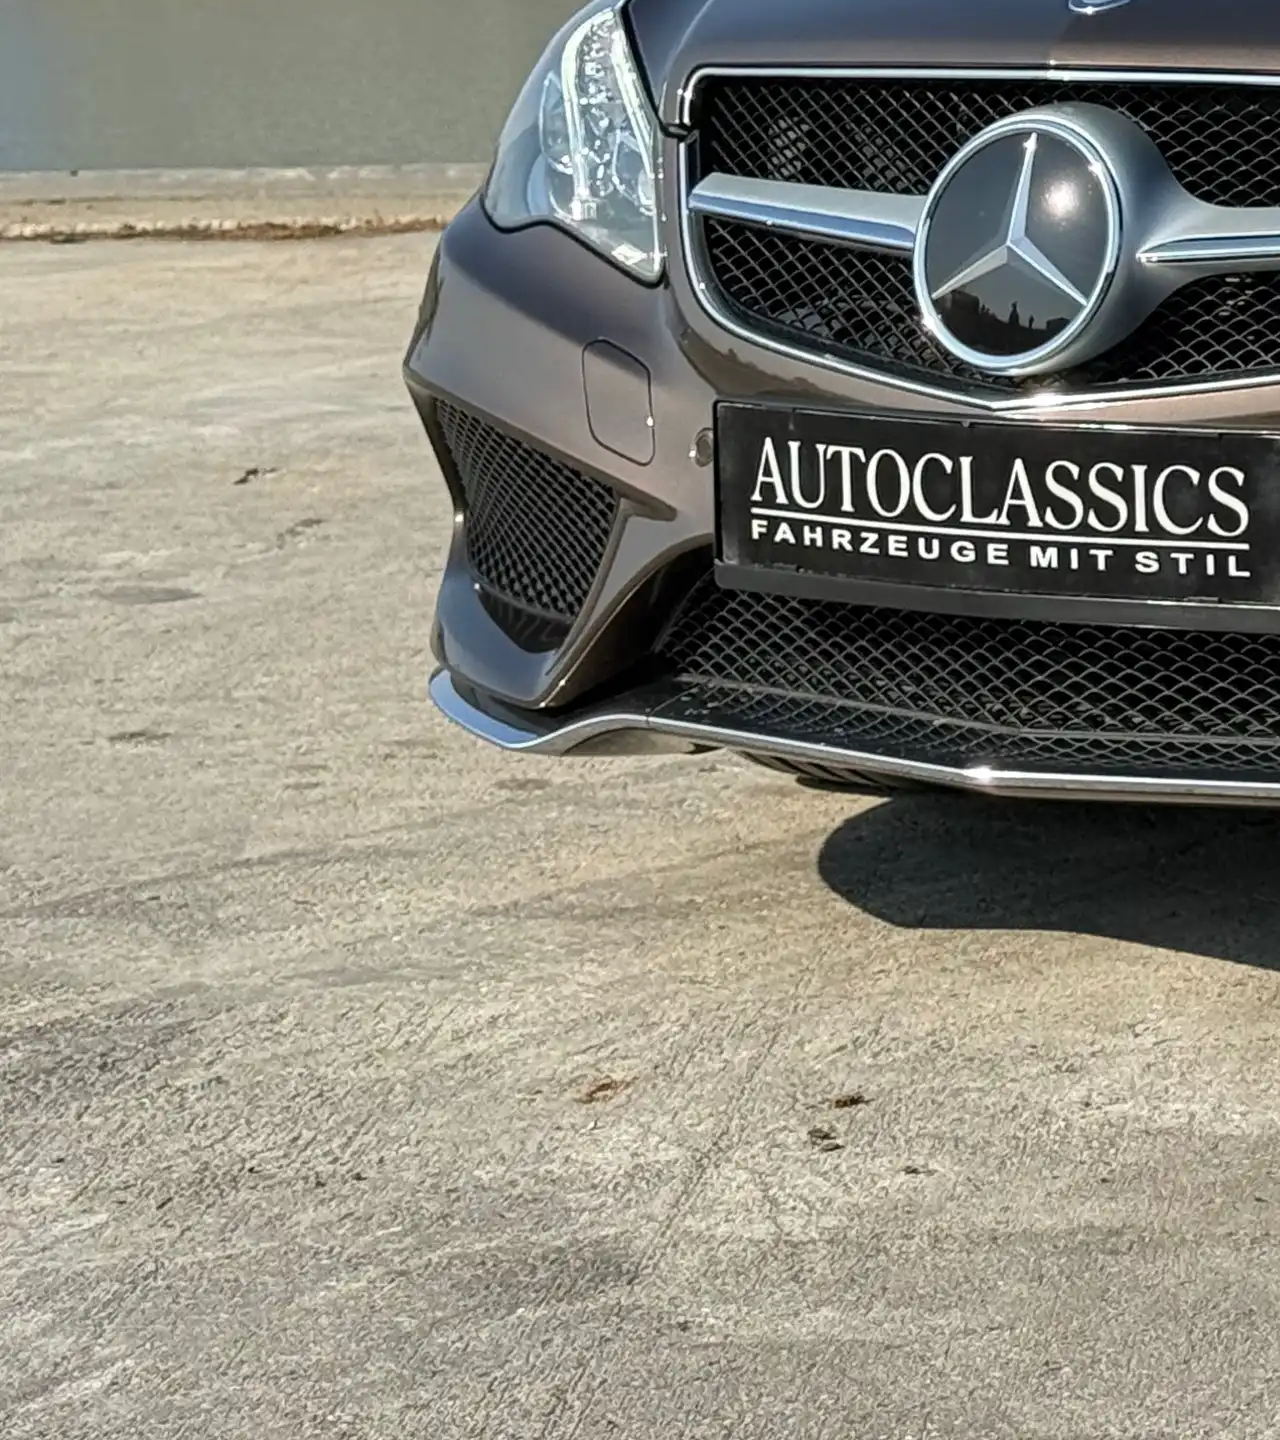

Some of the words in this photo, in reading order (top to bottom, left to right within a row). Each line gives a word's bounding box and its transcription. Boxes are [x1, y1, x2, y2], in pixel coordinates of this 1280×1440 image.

[750, 436, 1249, 538] AUTOCLASSICS
[751, 519, 1009, 565] FAHRZEUGE
[1029, 545, 1114, 571] MIT
[1134, 551, 1250, 578] STIL
